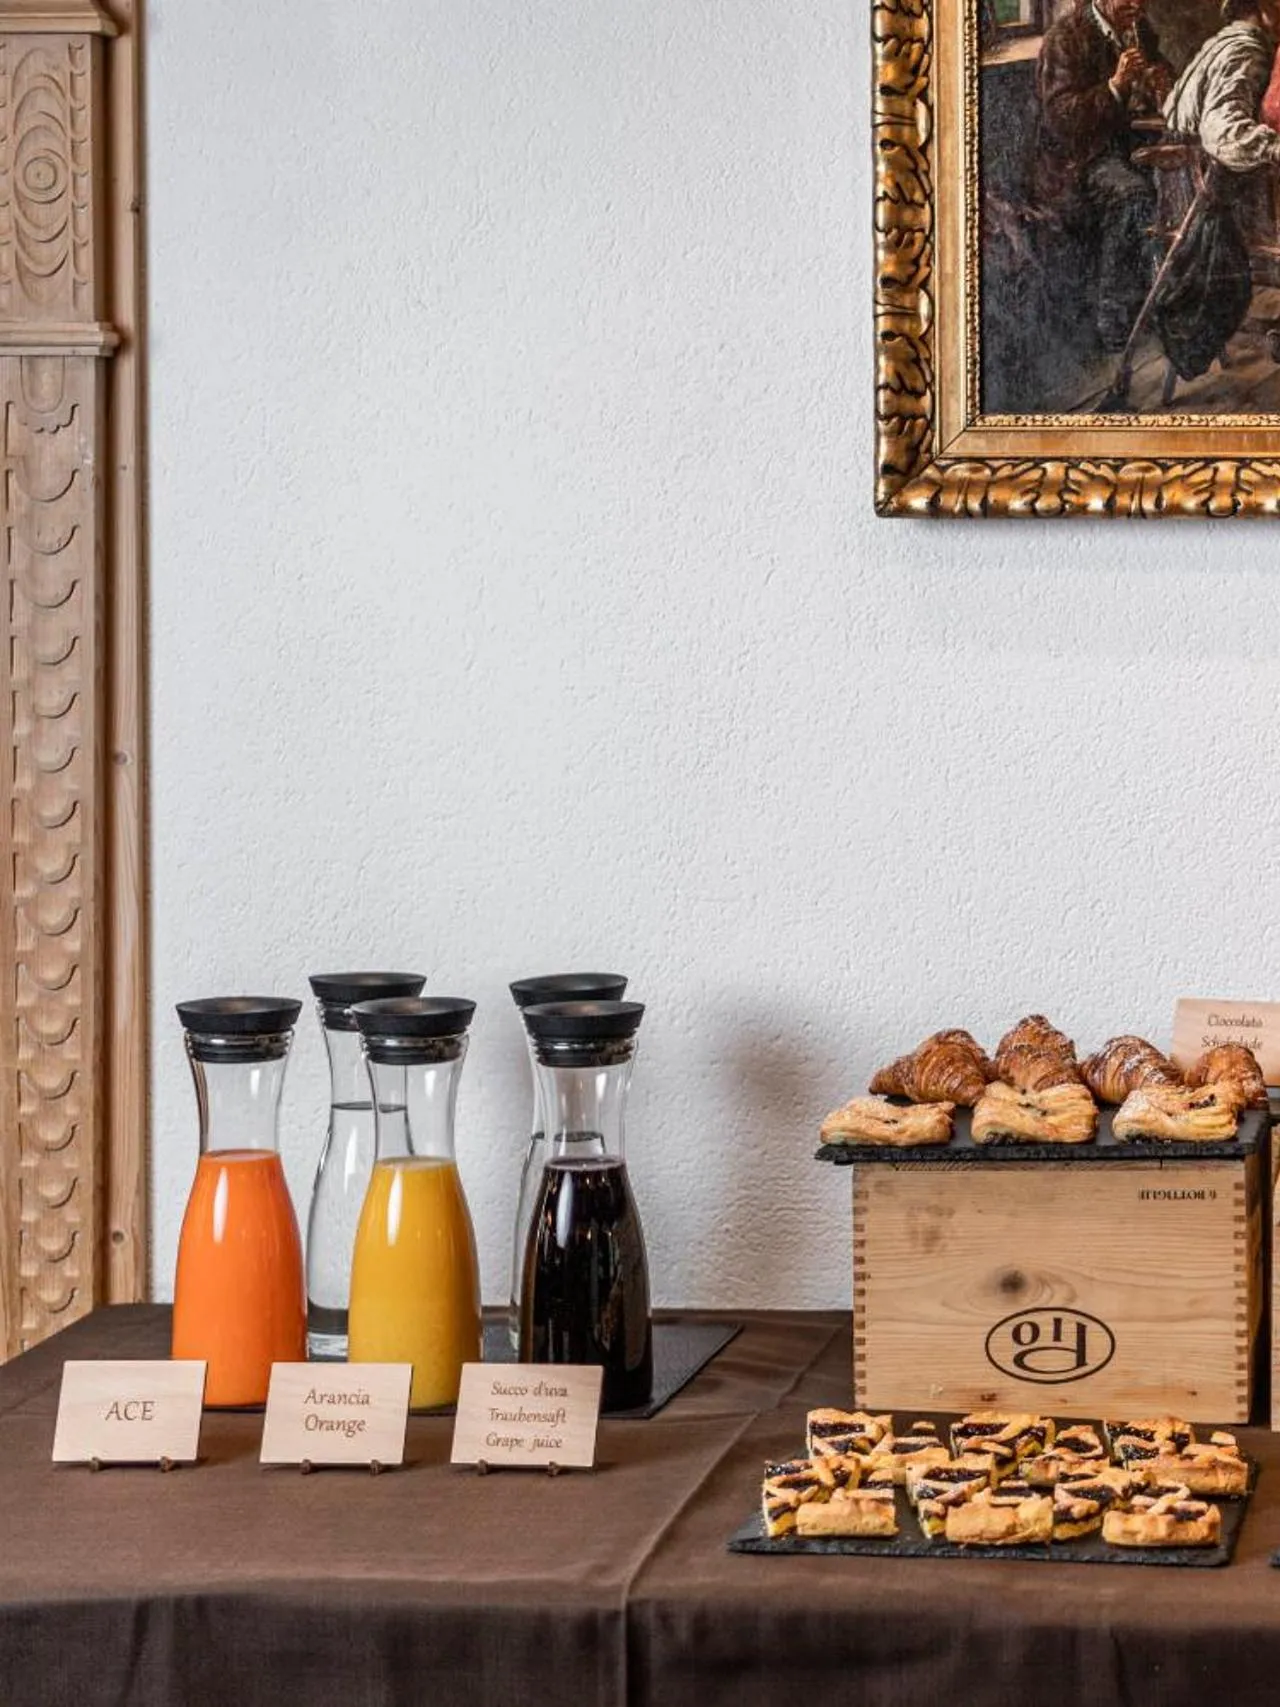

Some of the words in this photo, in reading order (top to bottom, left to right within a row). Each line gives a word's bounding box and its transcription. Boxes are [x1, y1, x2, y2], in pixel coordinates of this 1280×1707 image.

[1011, 1317, 1089, 1375] Pio
[302, 1387, 371, 1407] Arancia
[490, 1380, 529, 1398] Succo
[104, 1400, 155, 1422] ACE
[487, 1406, 567, 1426] Traubensaft
[303, 1414, 367, 1438] Orange
[485, 1432, 526, 1453] Grape
[528, 1434, 563, 1453] juice
